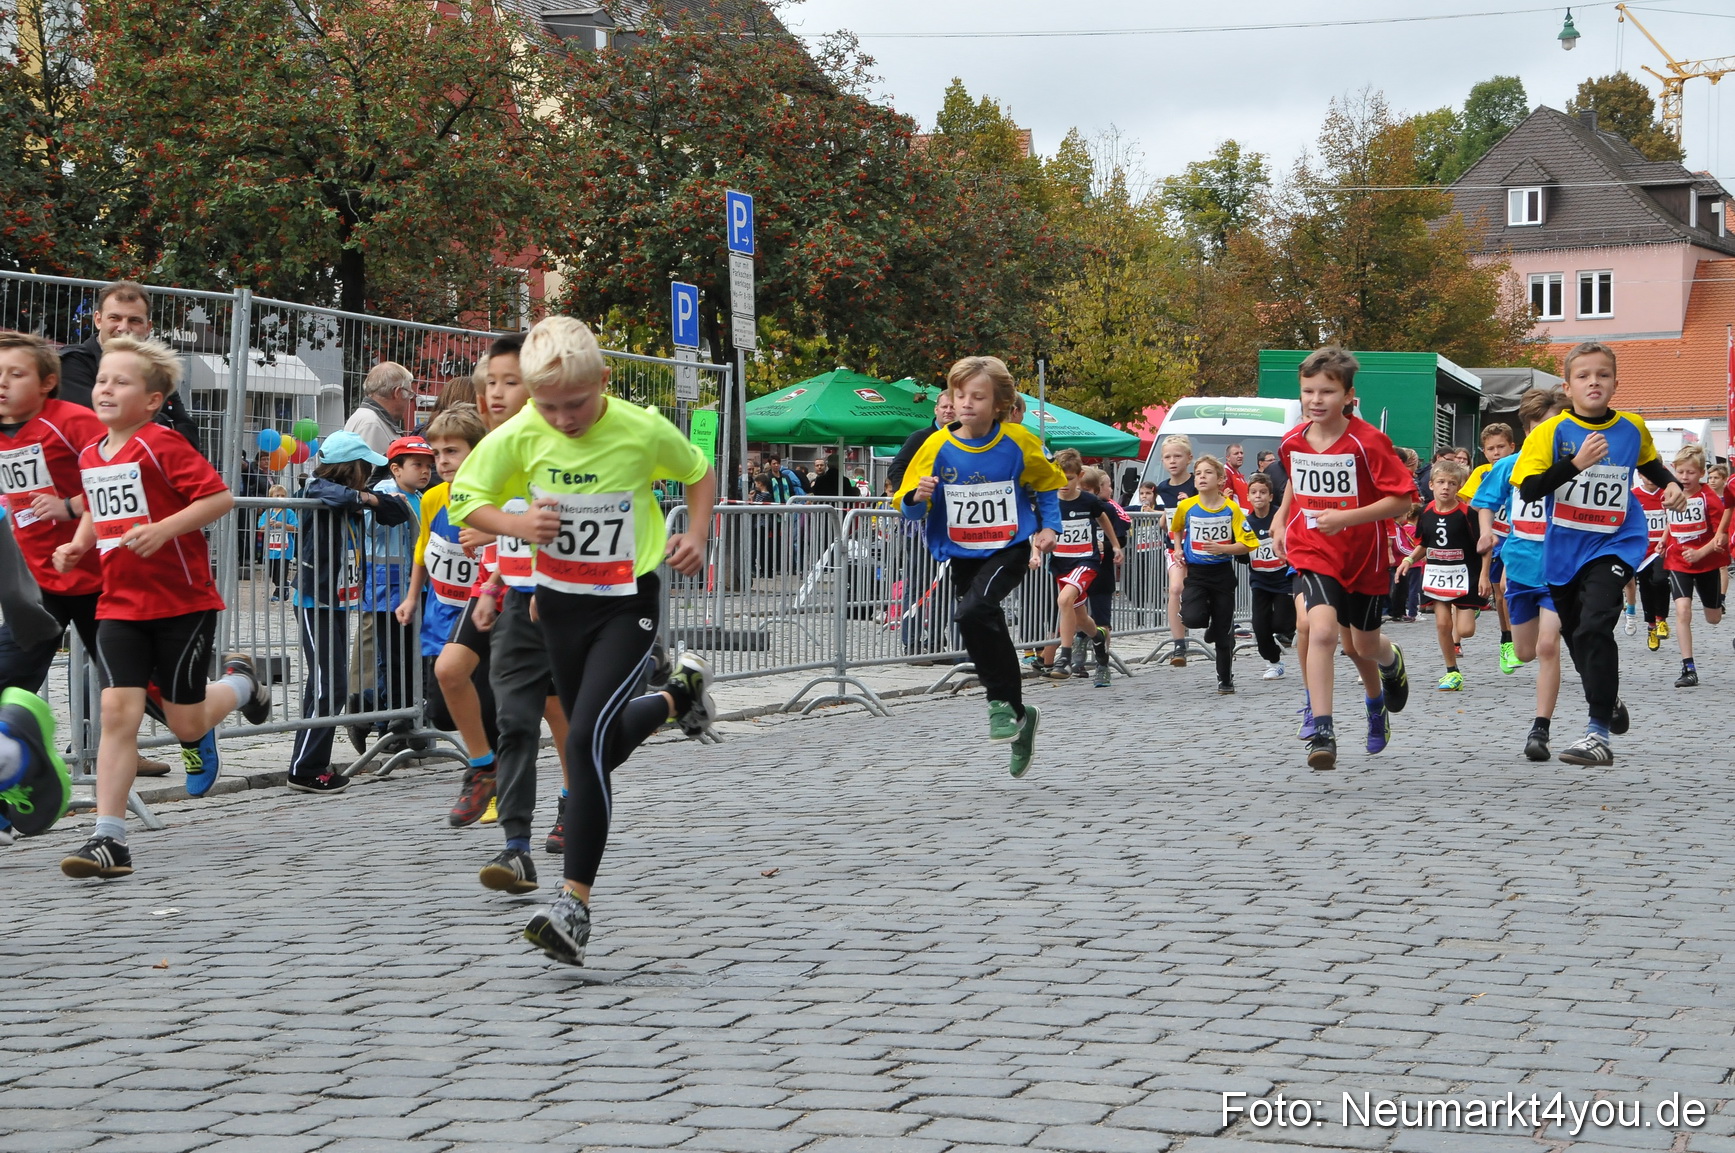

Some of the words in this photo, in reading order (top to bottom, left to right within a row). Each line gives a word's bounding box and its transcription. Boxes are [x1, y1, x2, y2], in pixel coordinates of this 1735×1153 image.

[733, 200, 747, 243] P
[678, 291, 692, 337] P
[547, 468, 598, 486] Team
[1296, 468, 1351, 494] 7098
[1585, 470, 1619, 480] Neumarkt
[946, 490, 968, 499] PARTL
[969, 489, 1003, 498] Neumarkt
[1564, 480, 1623, 508] 7162
[561, 503, 615, 515] Neumarkt
[953, 498, 1009, 525] 7201
[1572, 509, 1606, 523] Lorenz
[546, 517, 624, 557] 527
[961, 530, 1004, 541] Jonathan
[1193, 525, 1229, 541] 7528
[1435, 527, 1448, 547] 3
[430, 552, 480, 584] 719
[1429, 574, 1464, 588] 7512
[441, 585, 465, 598] Leon
